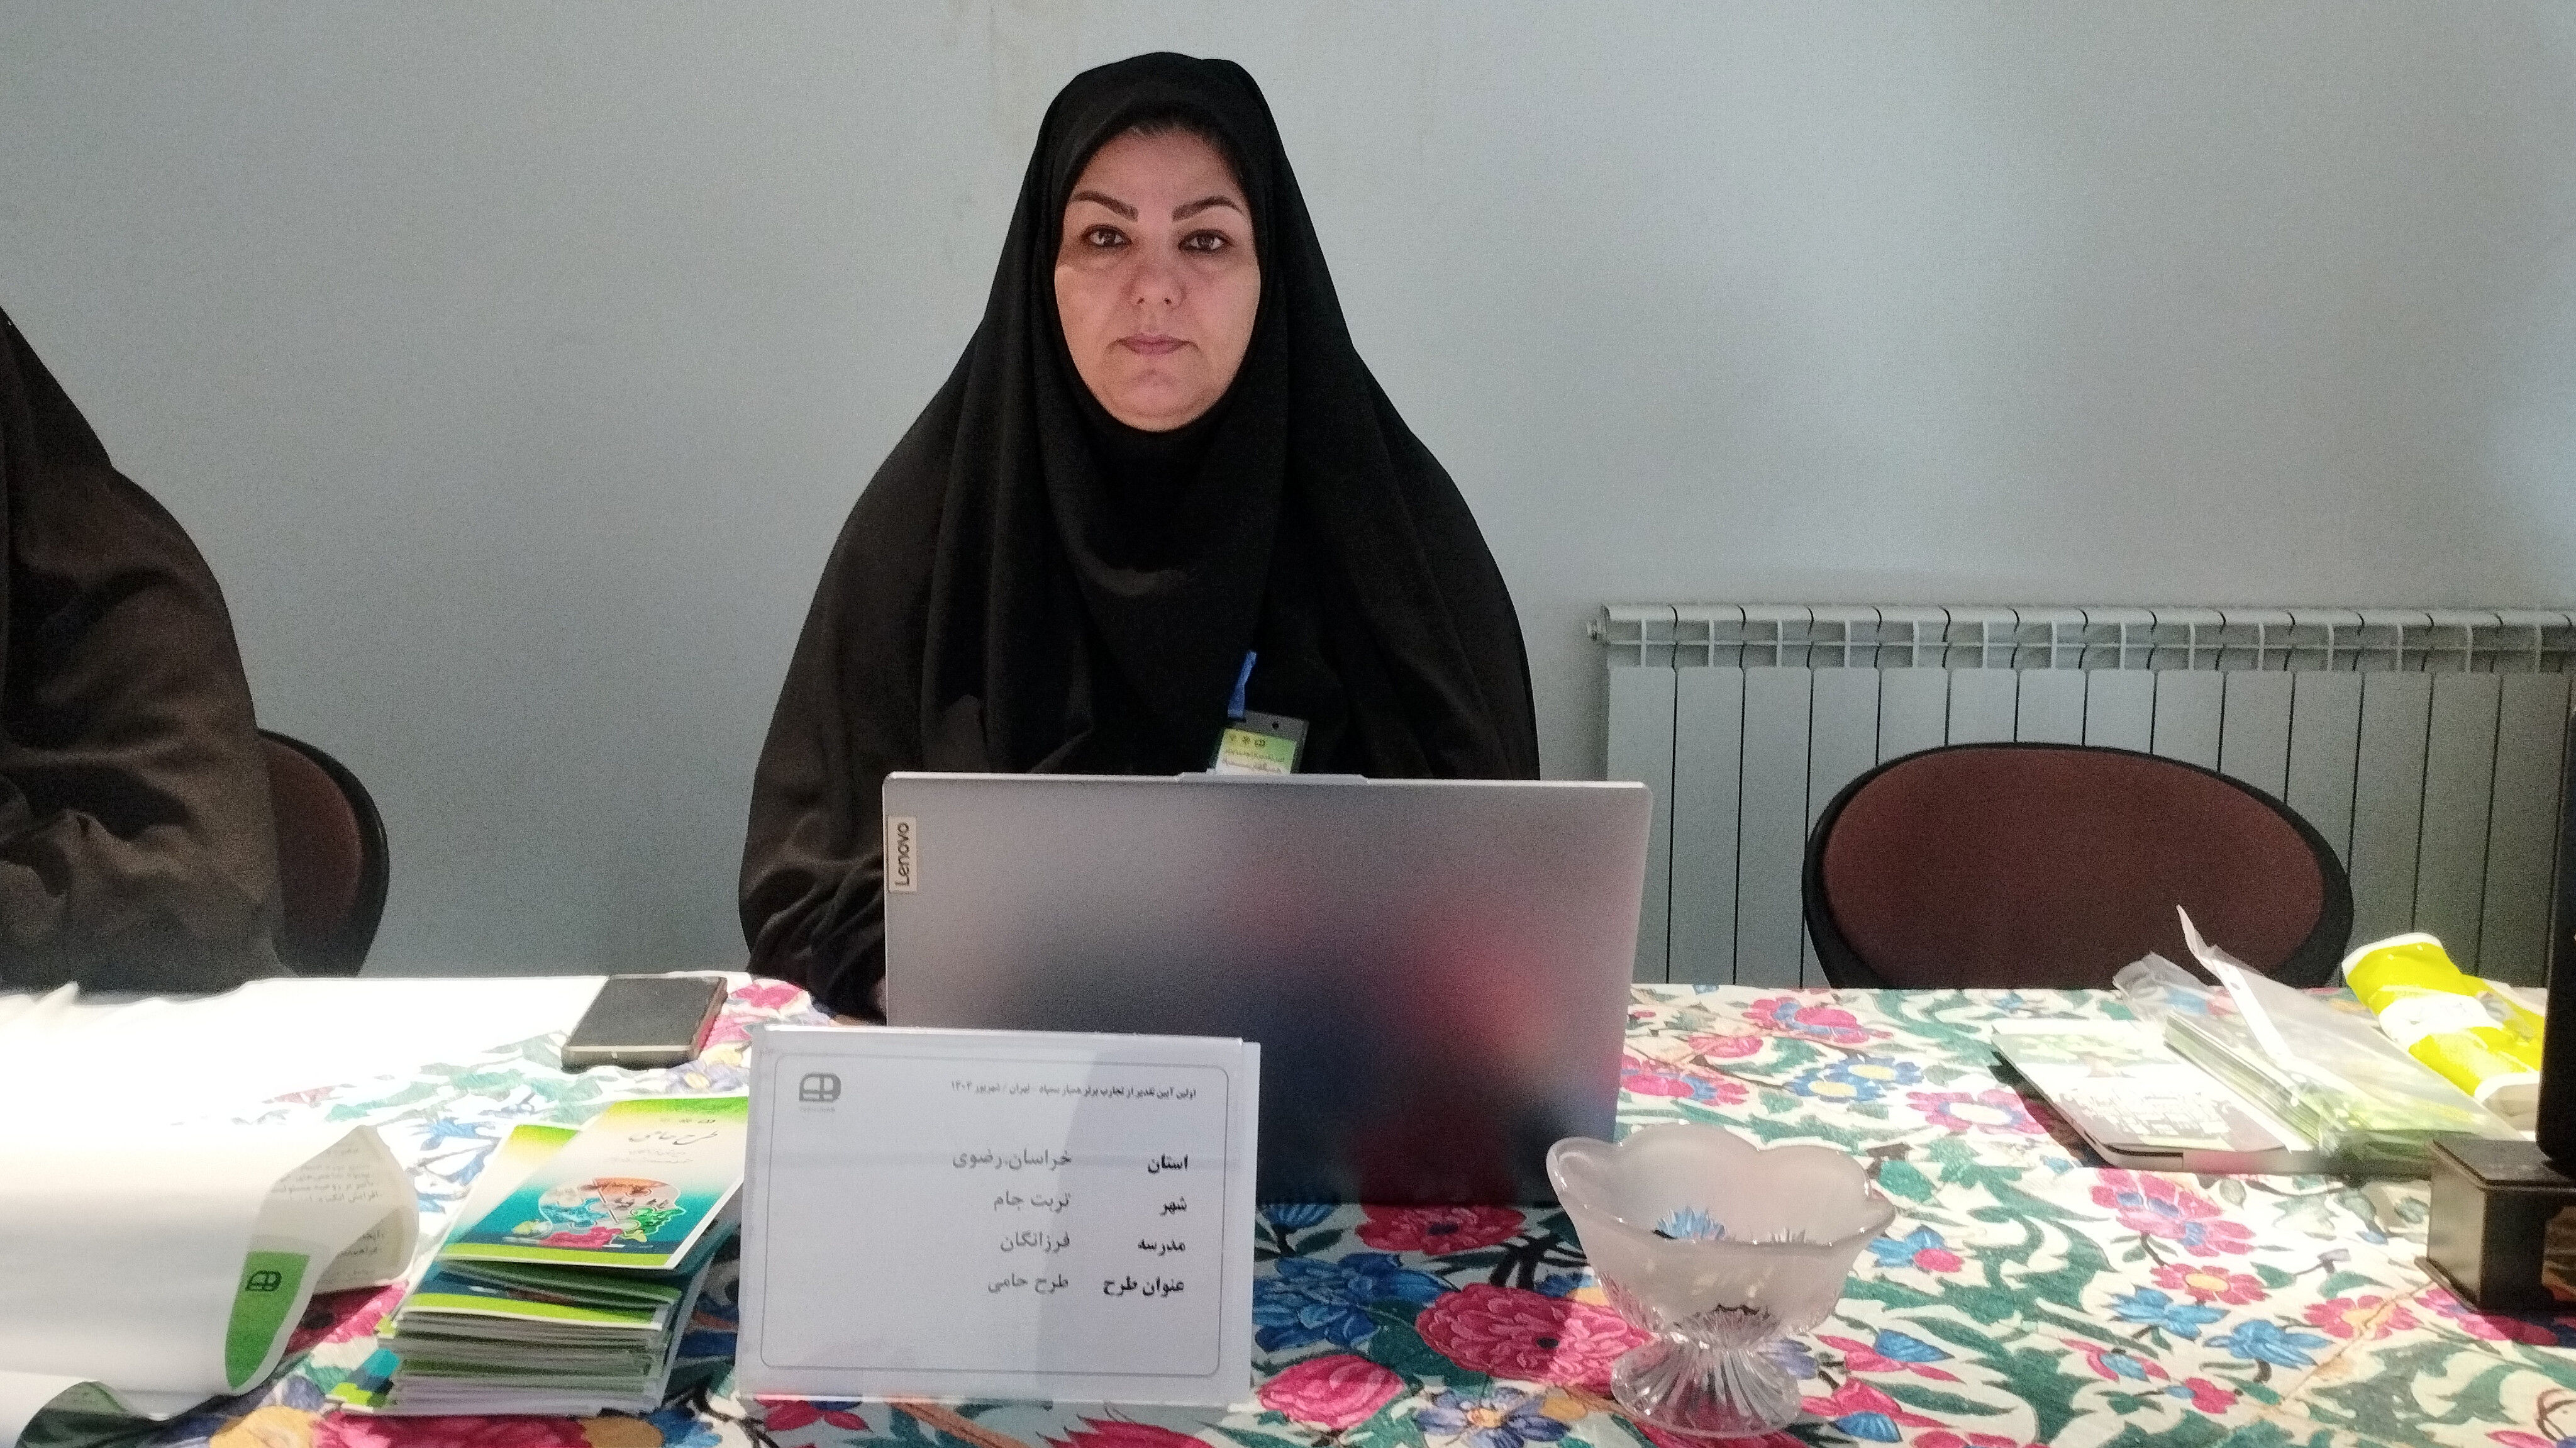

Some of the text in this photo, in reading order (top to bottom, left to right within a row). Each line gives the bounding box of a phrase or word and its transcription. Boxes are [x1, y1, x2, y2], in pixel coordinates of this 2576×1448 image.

[894, 822, 909, 886] Lenovo
[1148, 1153, 1188, 1174] استان
[994, 1189, 1187, 1216] شهر تربت جام
[1000, 1230, 1186, 1257] مدرسه فرزانگان
[988, 1272, 1184, 1298] عنوان طرح طرح حامی
